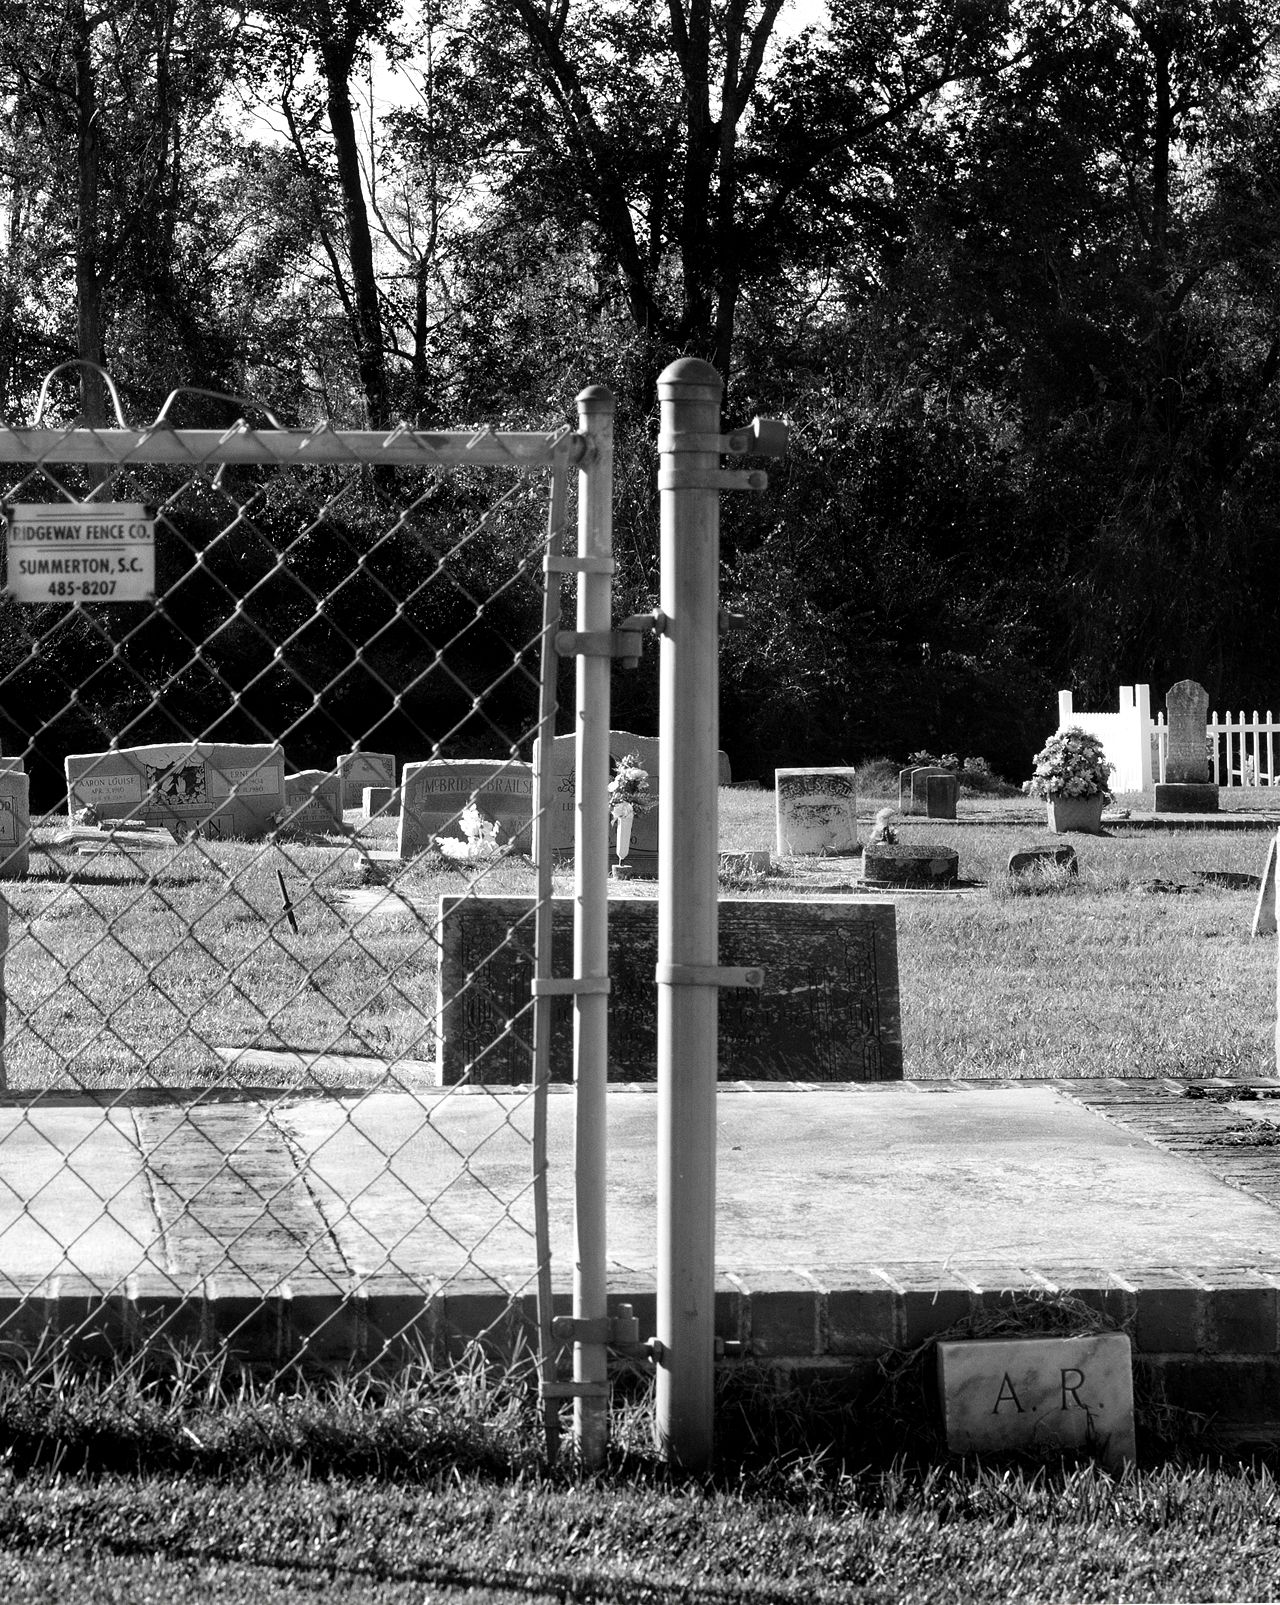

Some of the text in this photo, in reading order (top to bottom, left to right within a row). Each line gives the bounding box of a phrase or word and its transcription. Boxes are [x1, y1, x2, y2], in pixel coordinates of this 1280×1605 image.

[12, 524, 151, 541] RIDGEWAY FENCE CO.
[19, 557, 144, 575] SUMMERTON, S.C.
[48, 580, 117, 596] 485-8207
[108, 776, 135, 786] LOUISE
[991, 1370, 1038, 1415] A.
